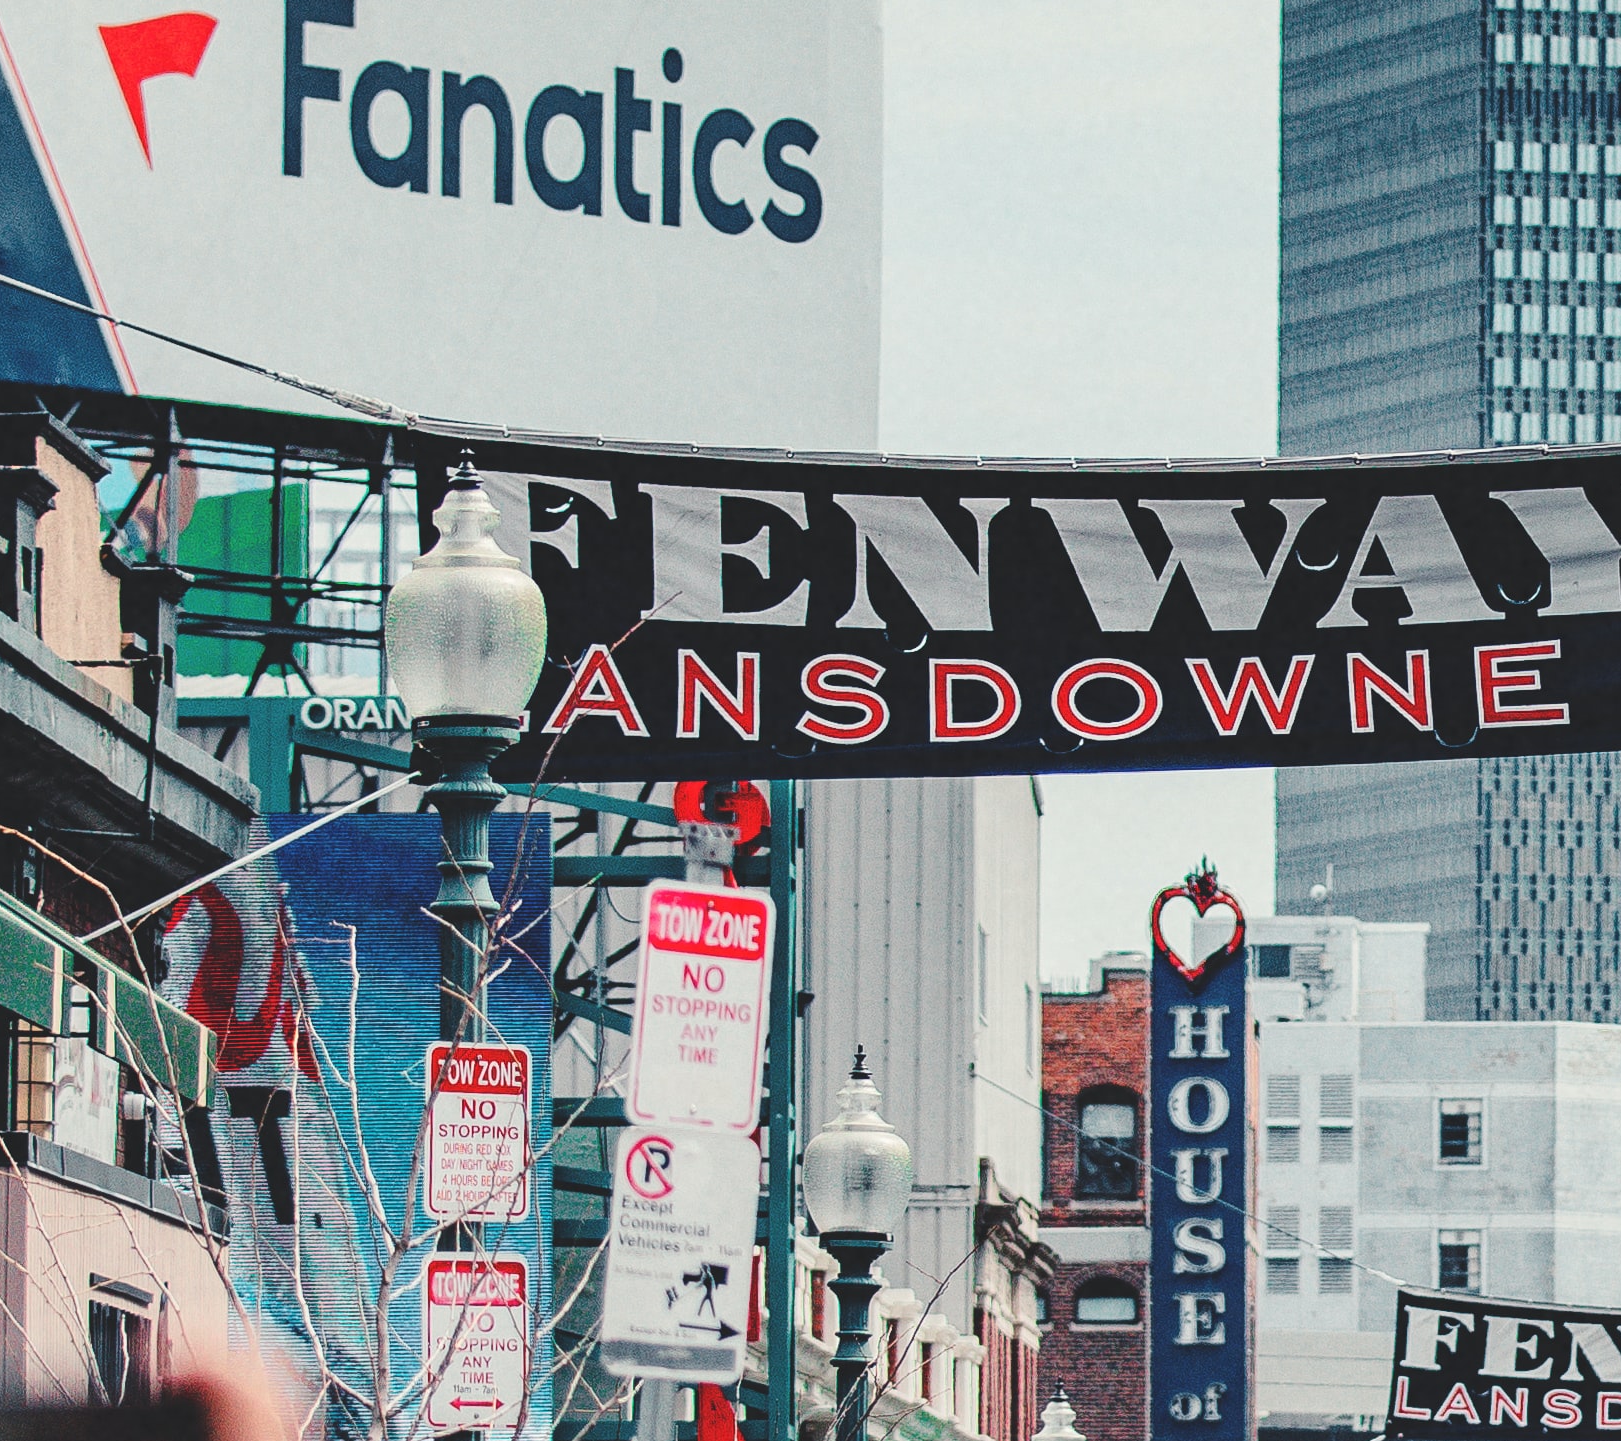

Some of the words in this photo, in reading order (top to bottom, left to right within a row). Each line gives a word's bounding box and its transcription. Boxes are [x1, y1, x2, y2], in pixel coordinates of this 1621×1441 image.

[520, 641, 1570, 744] ANSDOWNE
[300, 697, 413, 730] ORAN
[657, 903, 704, 944] TOW
[705, 909, 762, 952] ZONE
[682, 962, 725, 993] NO
[652, 994, 752, 1024] STOPPING
[680, 1023, 718, 1043] ANY
[678, 1044, 719, 1066] TIME
[477, 1060, 523, 1088] ZONE
[461, 1098, 497, 1120] NO
[438, 1123, 519, 1140] STOPPING
[443, 1143, 474, 1155] DURING
[476, 1143, 492, 1156] RED
[495, 1143, 512, 1156] SOX
[442, 1174, 448, 1185] 4
[450, 1174, 478, 1187] HOURS
[1166, 1004, 1231, 1346] HOUSE
[621, 1194, 674, 1214] Except
[619, 1213, 711, 1238] Commercial
[618, 1232, 681, 1253] Vehicles
[434, 1271, 472, 1298] TOW
[473, 1272, 520, 1300] ZONE
[463, 1312, 495, 1333] NO
[461, 1356, 493, 1368] ANY
[460, 1371, 495, 1385] TIME
[1167, 1382, 1229, 1423] of
